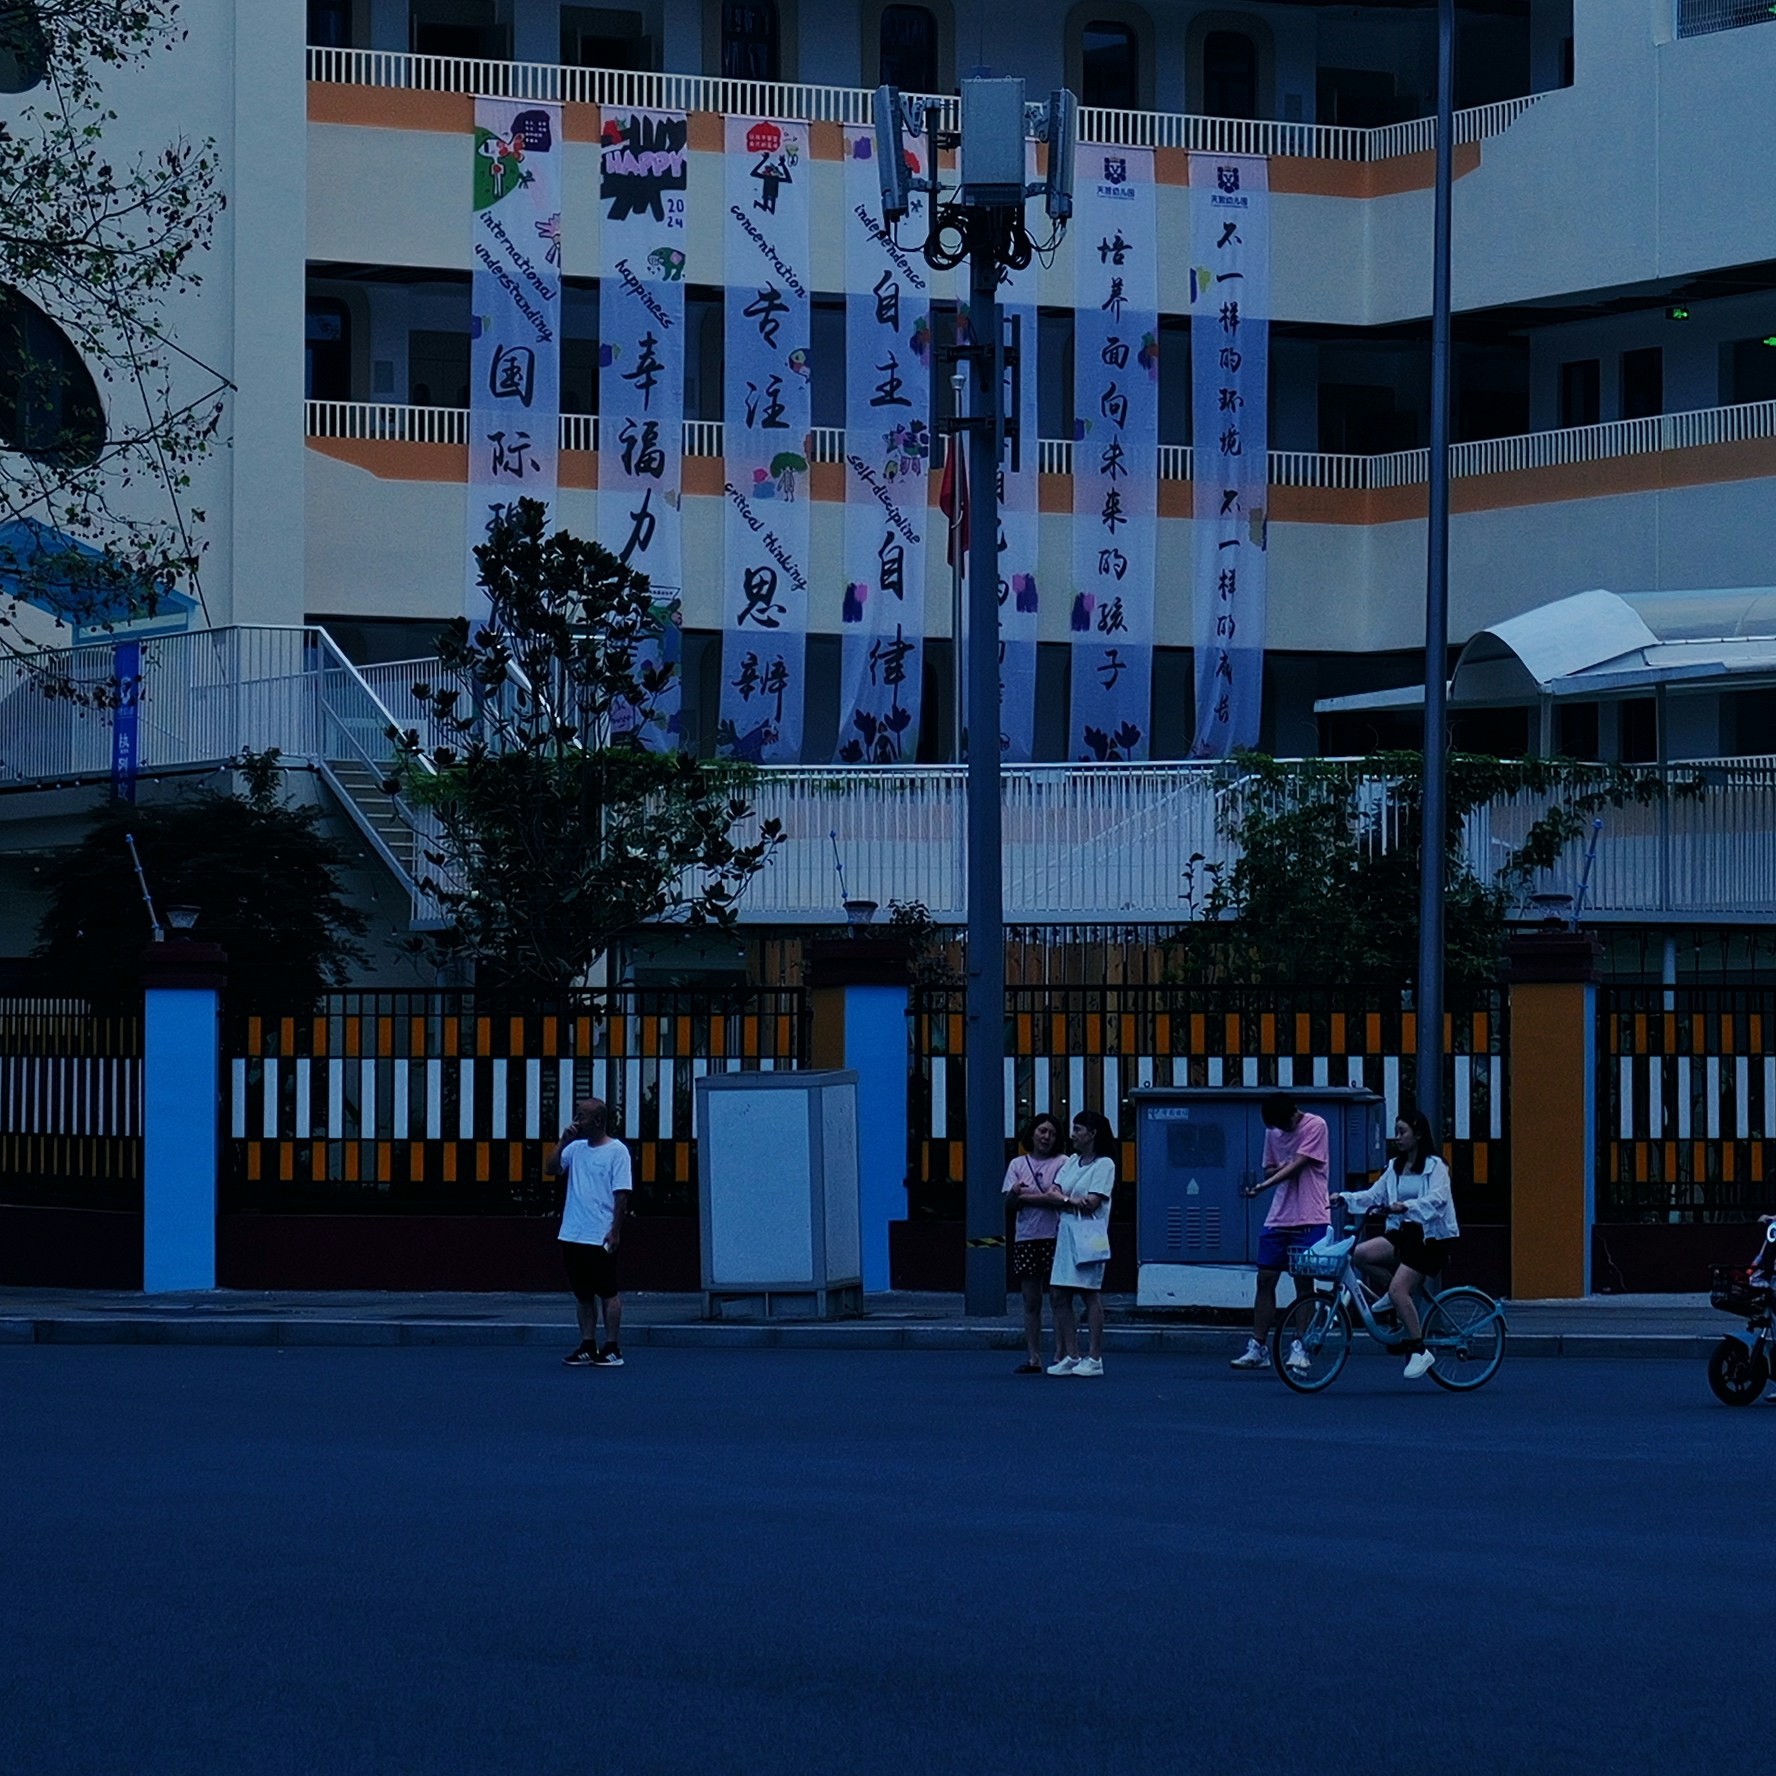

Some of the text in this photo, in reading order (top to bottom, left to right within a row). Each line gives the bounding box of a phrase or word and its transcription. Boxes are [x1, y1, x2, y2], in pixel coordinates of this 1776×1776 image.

[605, 149, 684, 178] HAPPY
[668, 198, 684, 213] 20
[479, 210, 558, 302] international
[667, 218, 683, 229] 24
[730, 204, 807, 300] concentration
[853, 203, 927, 290] independence
[474, 243, 553, 343] understanding
[614, 258, 675, 330] happiness
[869, 269, 912, 407] 自主
[846, 454, 921, 546] self-discipline
[1096, 228, 1134, 692] 培养面向未来的孩子
[724, 482, 808, 592] critical thinking
[731, 565, 790, 724] 思辨
[869, 530, 916, 708] 自律
